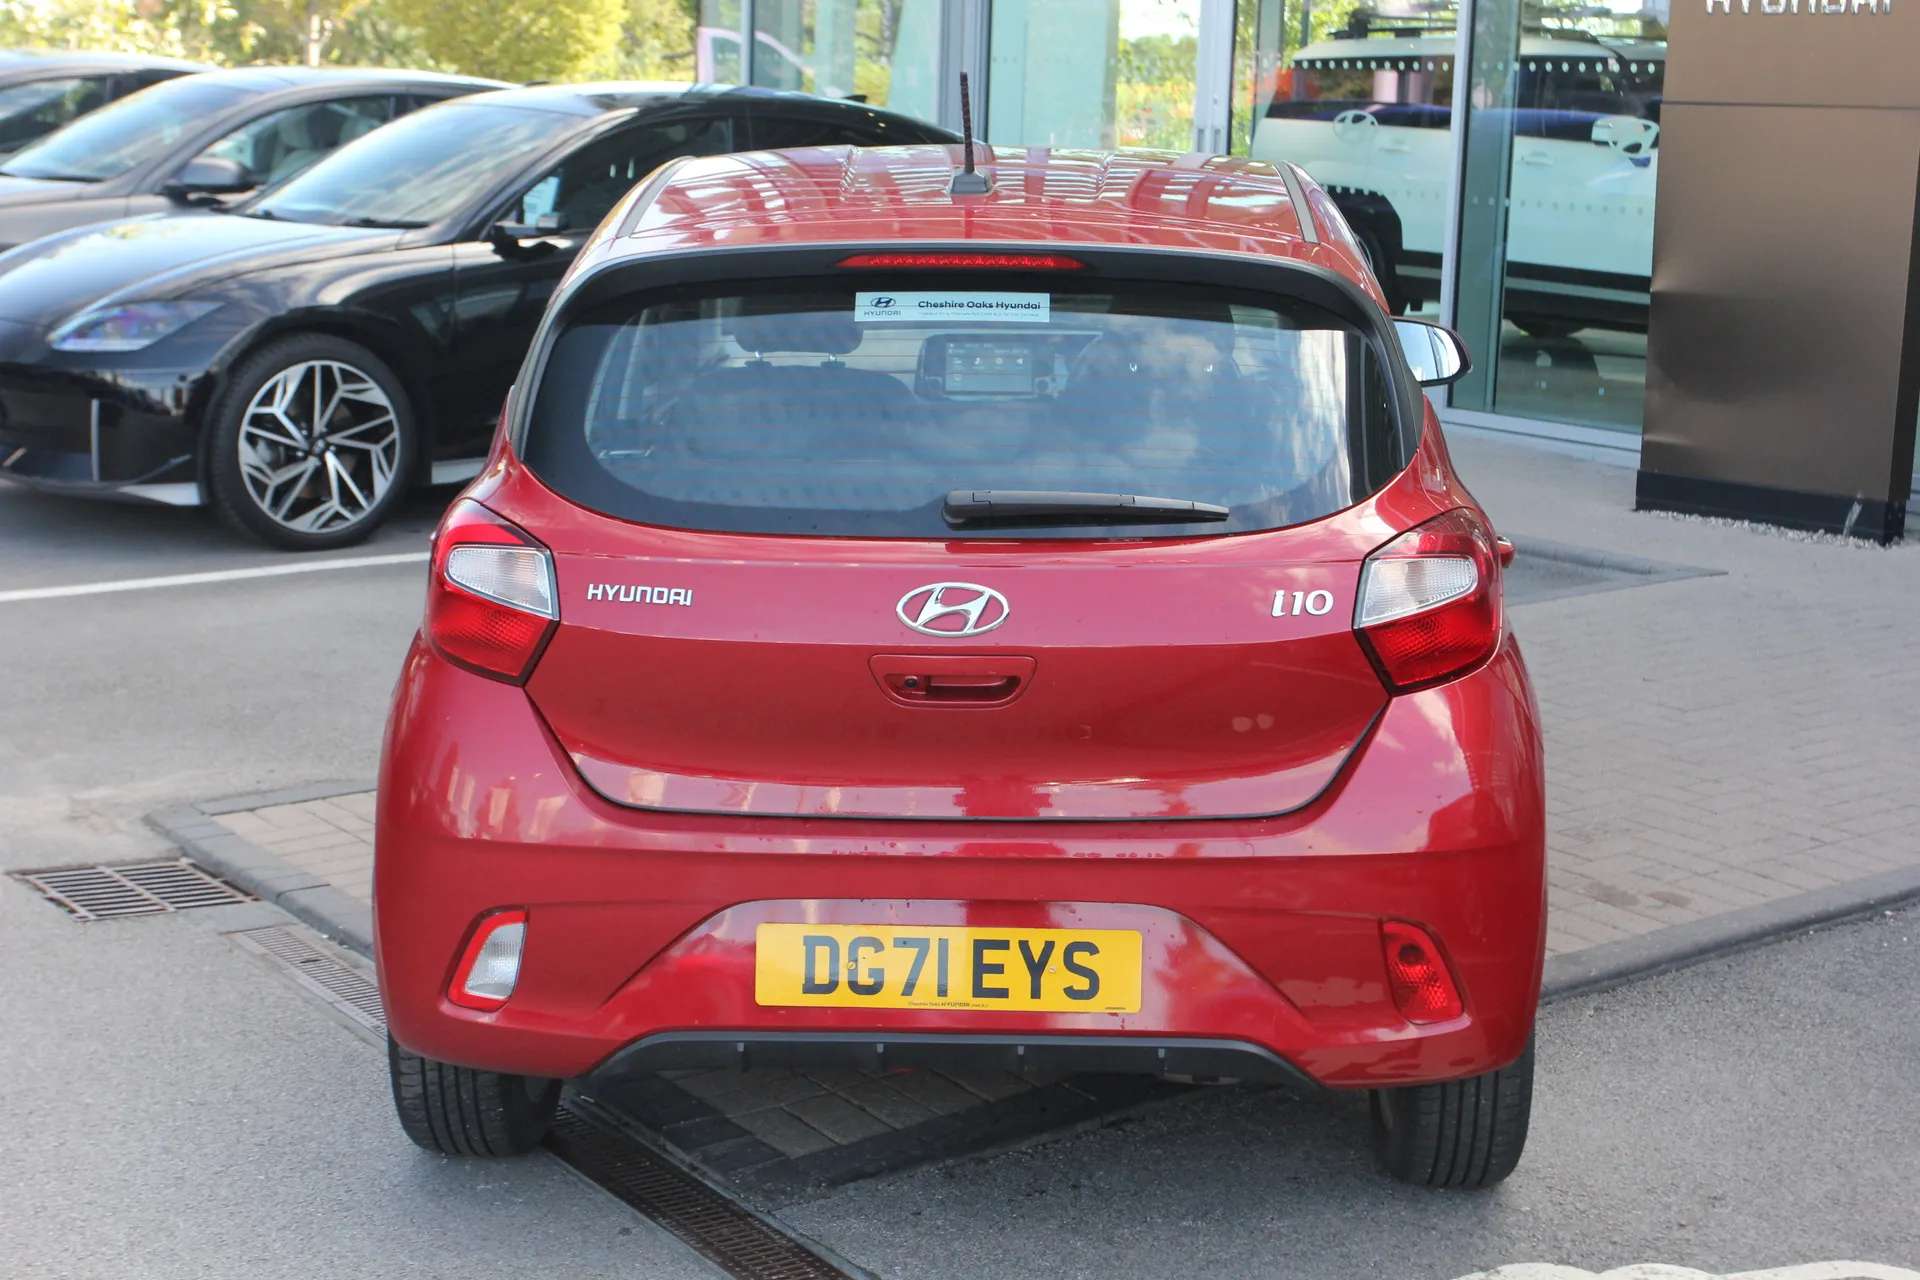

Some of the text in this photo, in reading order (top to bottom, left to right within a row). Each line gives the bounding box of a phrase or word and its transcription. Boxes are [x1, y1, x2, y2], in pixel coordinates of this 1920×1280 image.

[918, 300, 1041, 310] Cheshire Oaks Hyundai
[587, 583, 693, 606] HYUNDAI
[1271, 590, 1334, 617] i10
[802, 935, 1101, 1000] DG71 EYS
